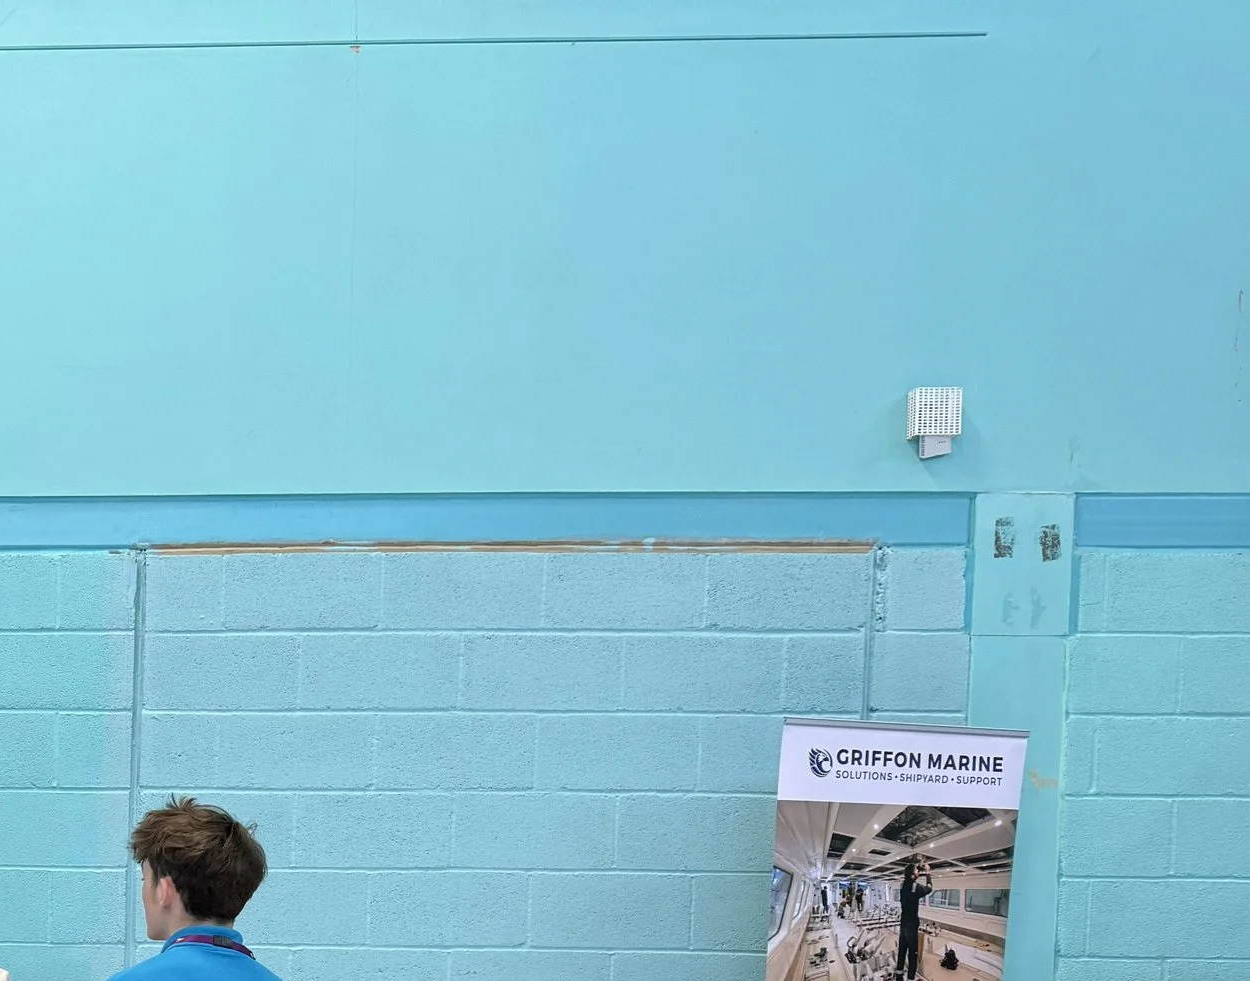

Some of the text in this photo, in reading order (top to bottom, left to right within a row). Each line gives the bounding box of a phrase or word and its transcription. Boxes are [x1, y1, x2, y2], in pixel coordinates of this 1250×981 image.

[836, 748, 1004, 773] GRIFFON MARINE
[835, 770, 1003, 787] SOLUTIONS SHIPYARD SUPPORT
